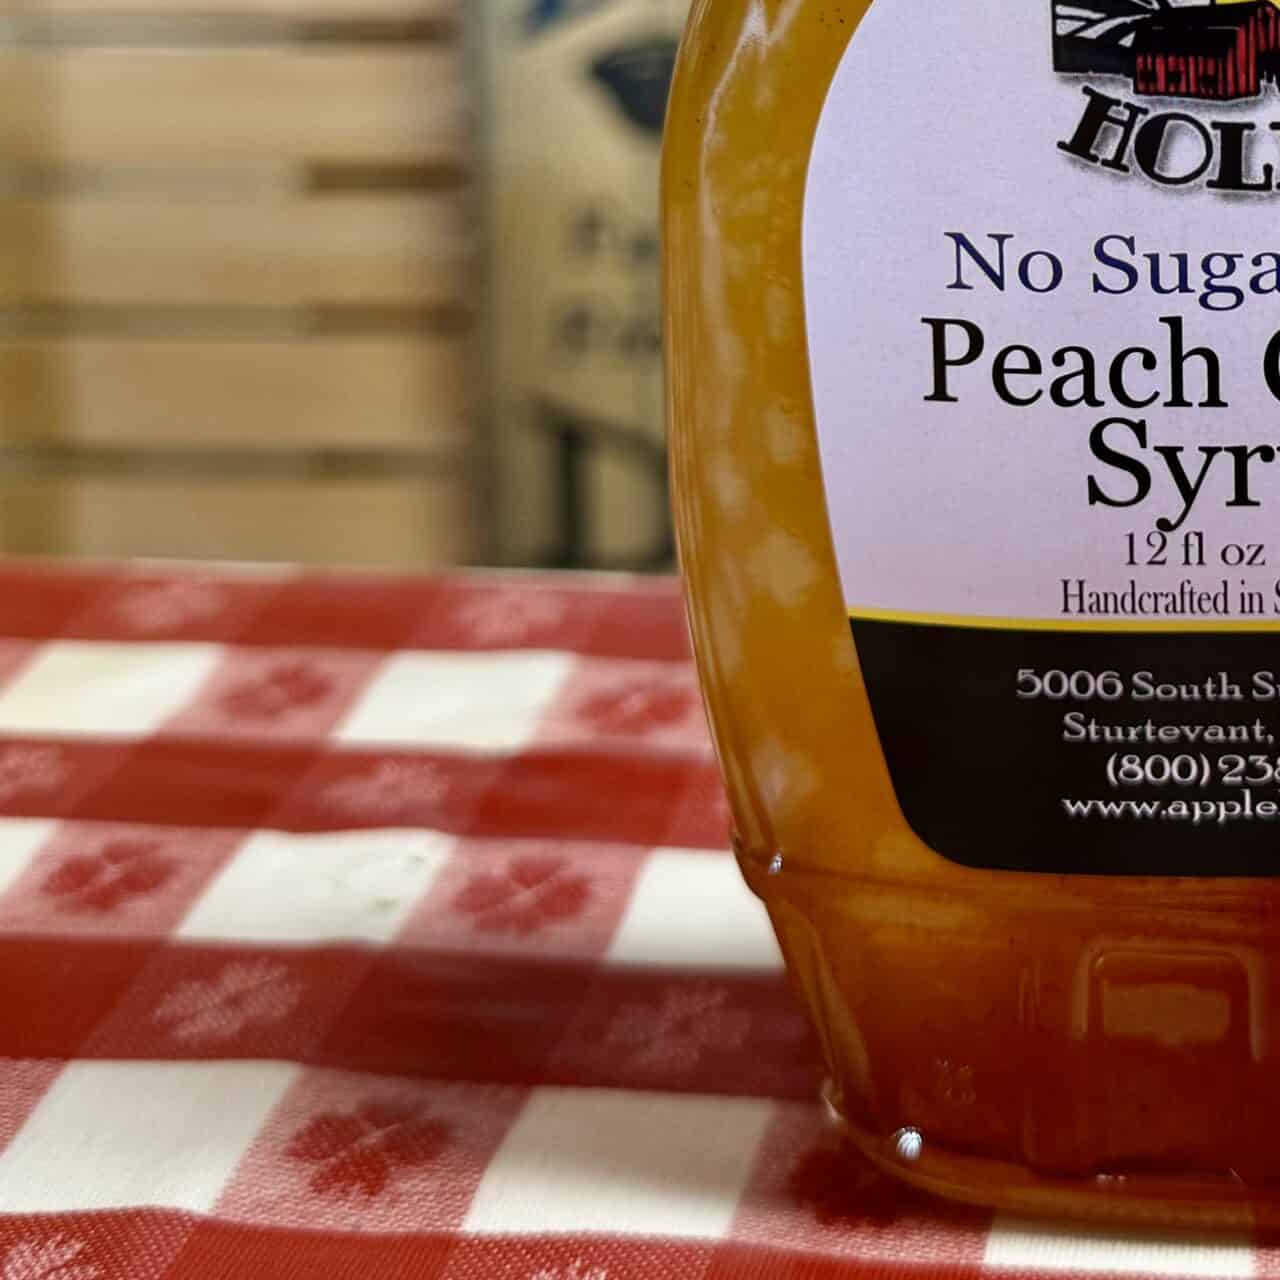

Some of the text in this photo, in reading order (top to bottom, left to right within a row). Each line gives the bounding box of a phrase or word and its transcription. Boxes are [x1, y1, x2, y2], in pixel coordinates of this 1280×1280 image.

[943, 231, 1063, 293] No
[920, 315, 1229, 409] Peach
[1125, 531, 1169, 566] 12
[1181, 531, 1206, 566] fl
[1220, 543, 1266, 566] oz
[1061, 578, 1230, 615] Handcrafted
[1239, 579, 1265, 615] in
[1017, 669, 1124, 699] 5006
[1131, 671, 1243, 700] South
[1063, 711, 1274, 743] Sturtevant,
[1106, 753, 1211, 786] (800)
